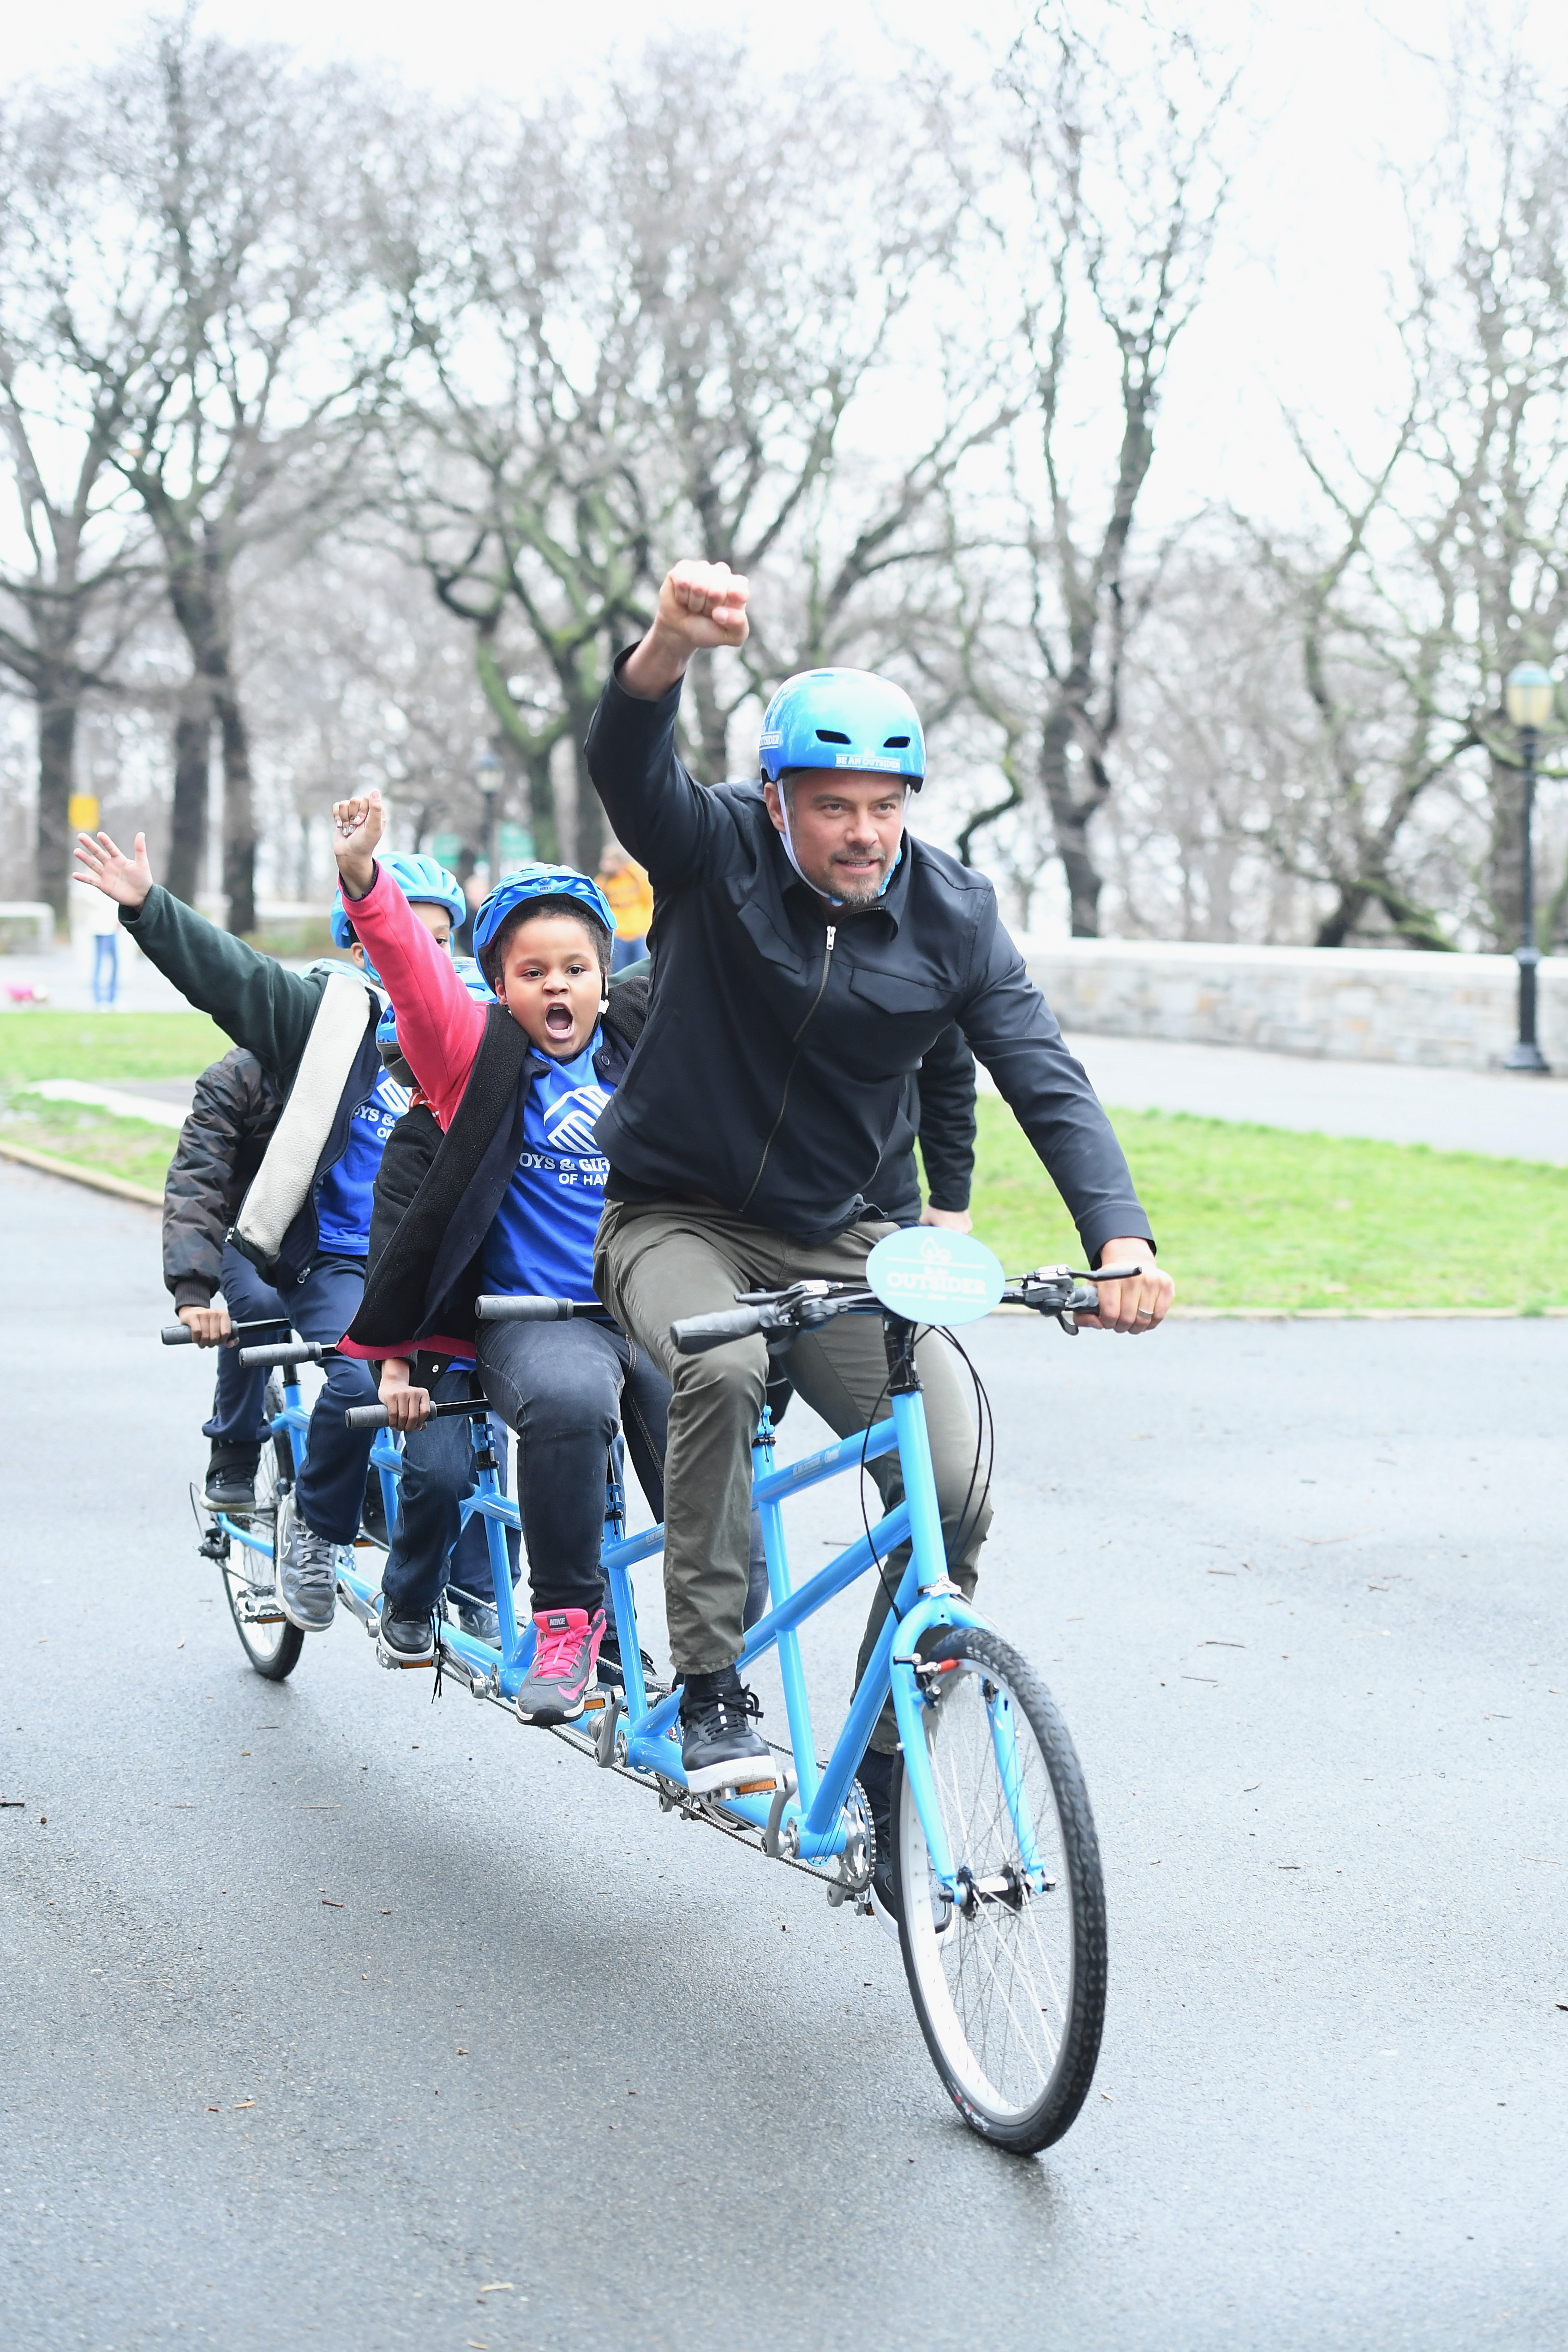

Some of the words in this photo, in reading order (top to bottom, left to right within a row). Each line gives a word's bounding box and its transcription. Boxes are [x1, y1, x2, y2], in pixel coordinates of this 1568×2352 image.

[836, 756, 847, 764] BE
[848, 756, 862, 765] AN
[862, 757, 901, 769] OUTSIDER
[381, 1113, 396, 1127] &
[560, 1159, 577, 1171] &
[558, 1173, 578, 1185] OF
[886, 1271, 987, 1295] OUTSIDER
[550, 1617, 566, 1626] NIKE
